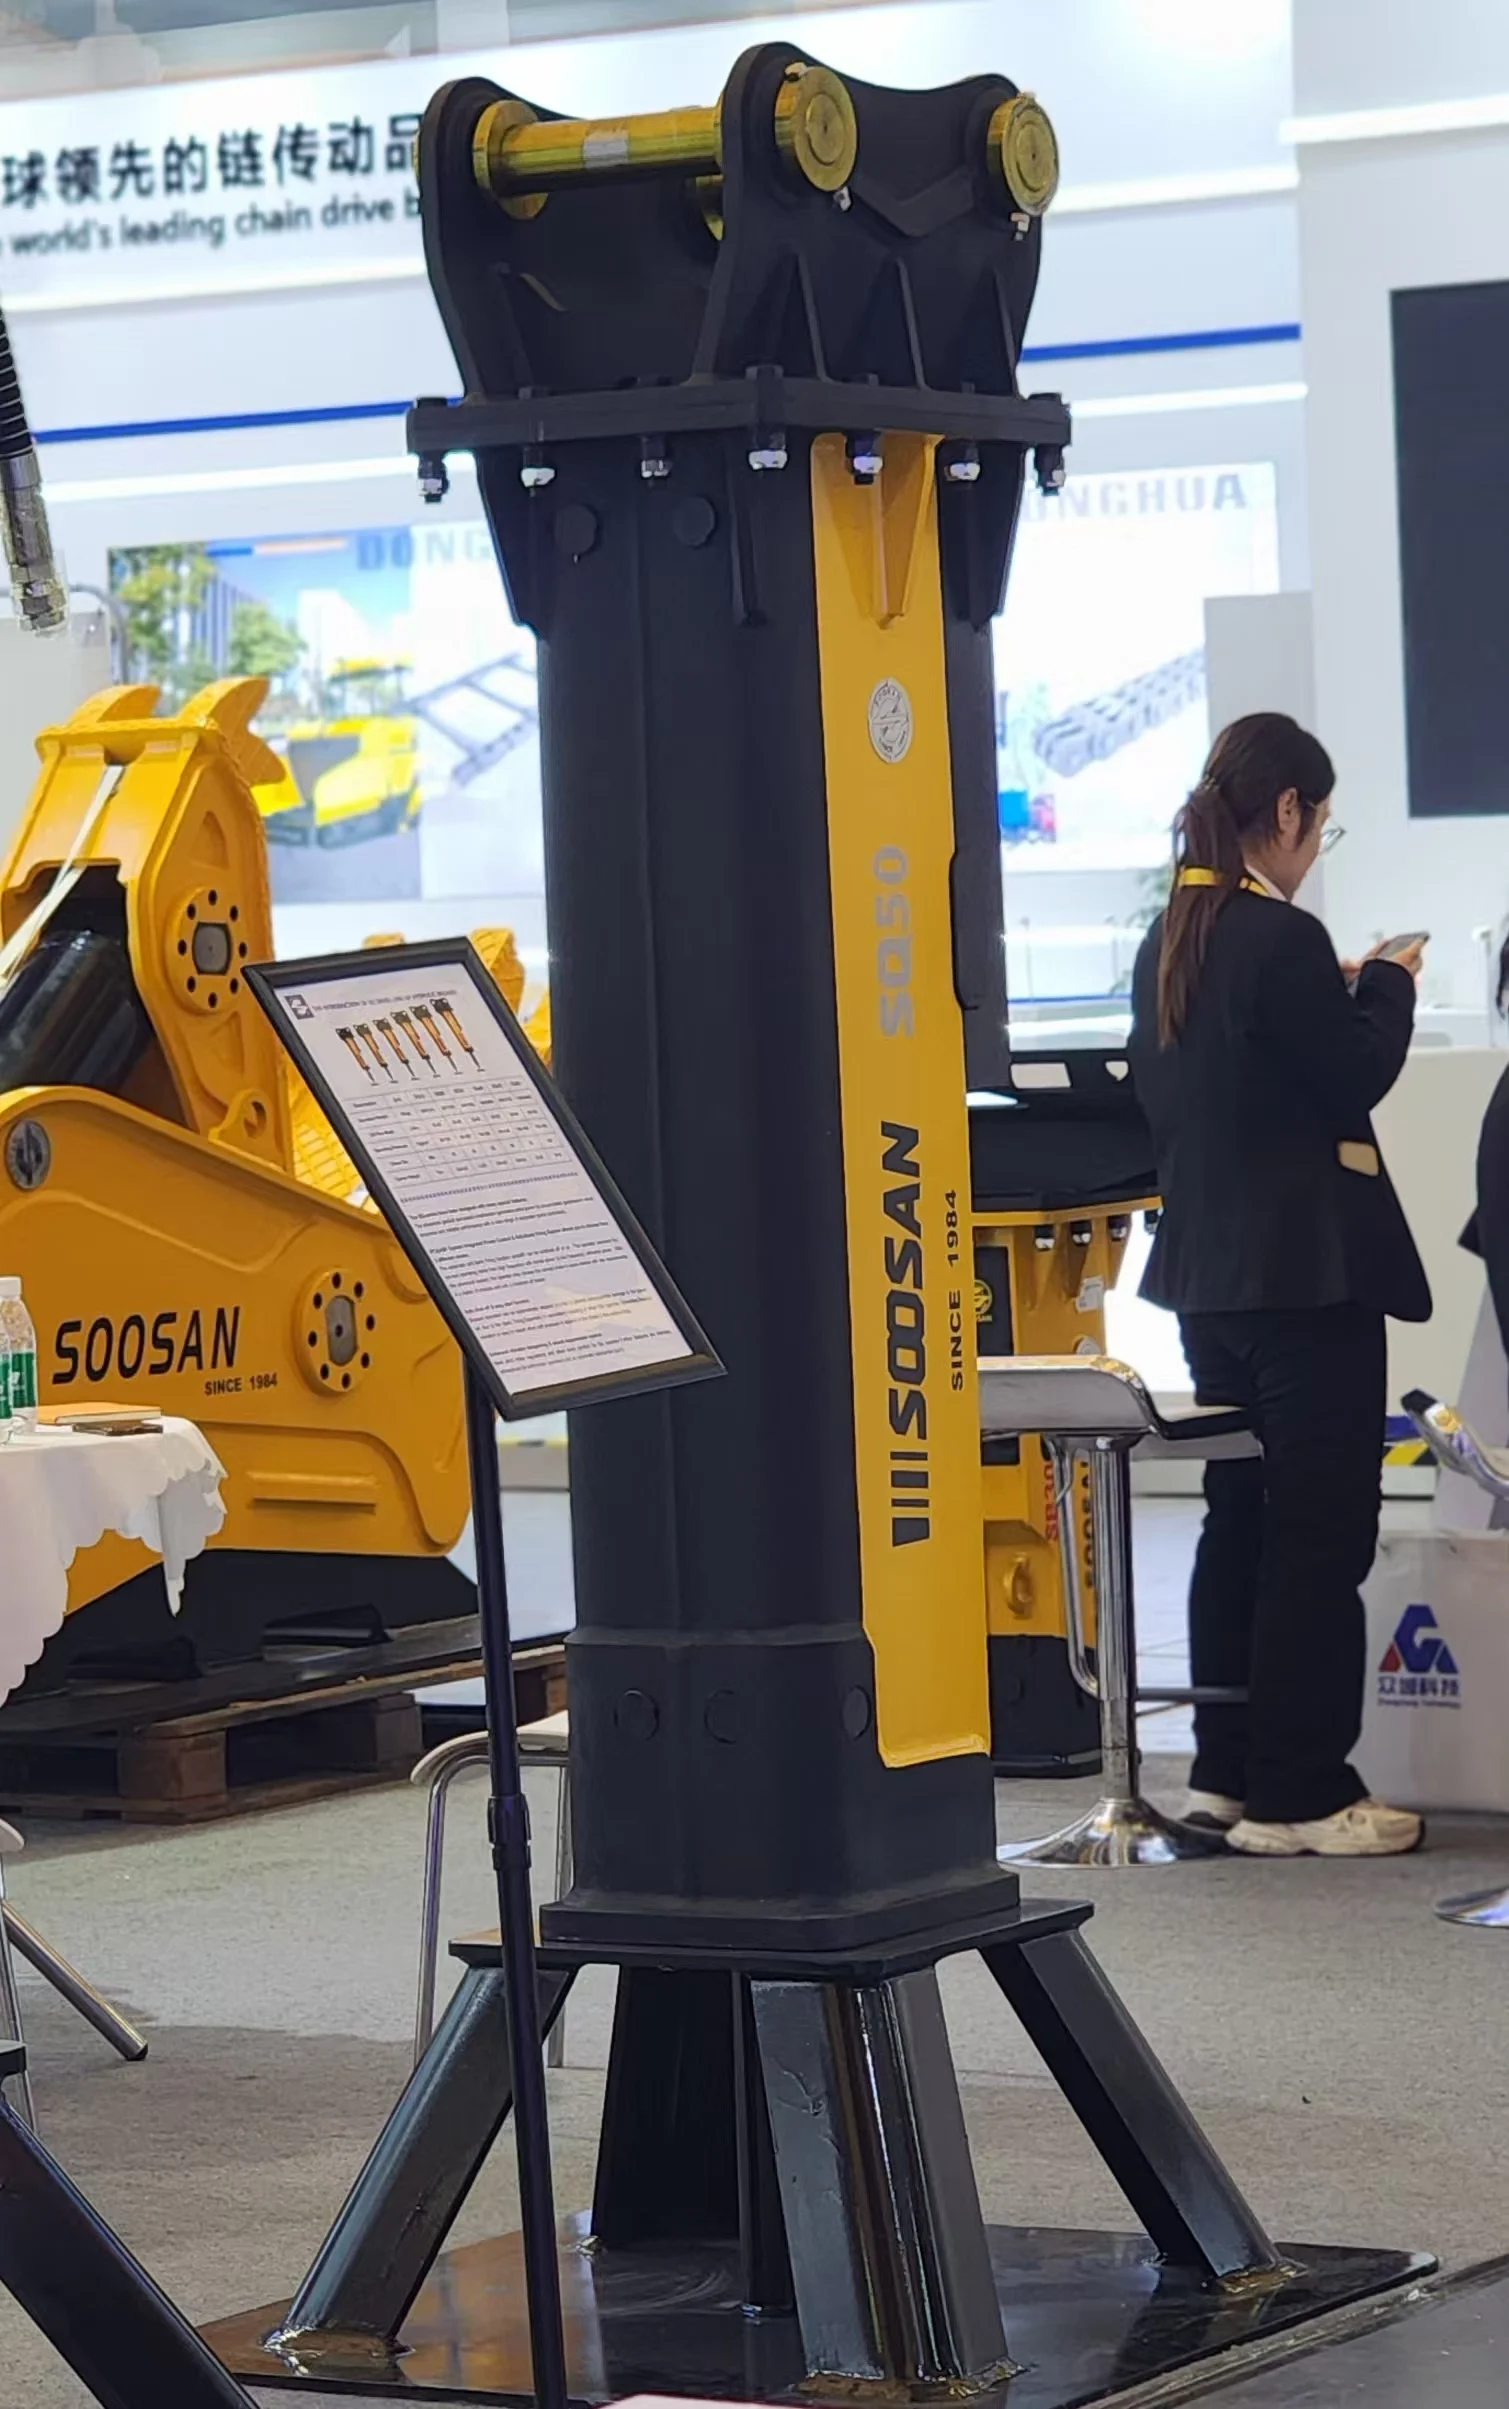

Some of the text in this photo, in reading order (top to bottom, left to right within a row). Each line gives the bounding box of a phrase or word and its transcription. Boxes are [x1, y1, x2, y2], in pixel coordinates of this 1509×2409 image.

[11, 217, 112, 254] world's
[119, 209, 225, 249] leading
[235, 200, 312, 236] chain
[320, 192, 394, 228] drive
[873, 843, 916, 1039] SQ50
[52, 1305, 240, 1385] SOOSAN
[880, 1120, 927, 1441] SOOSAN
[944, 1189, 963, 1391] SINCE 1984
[204, 1372, 278, 1396] SINCE 1984
